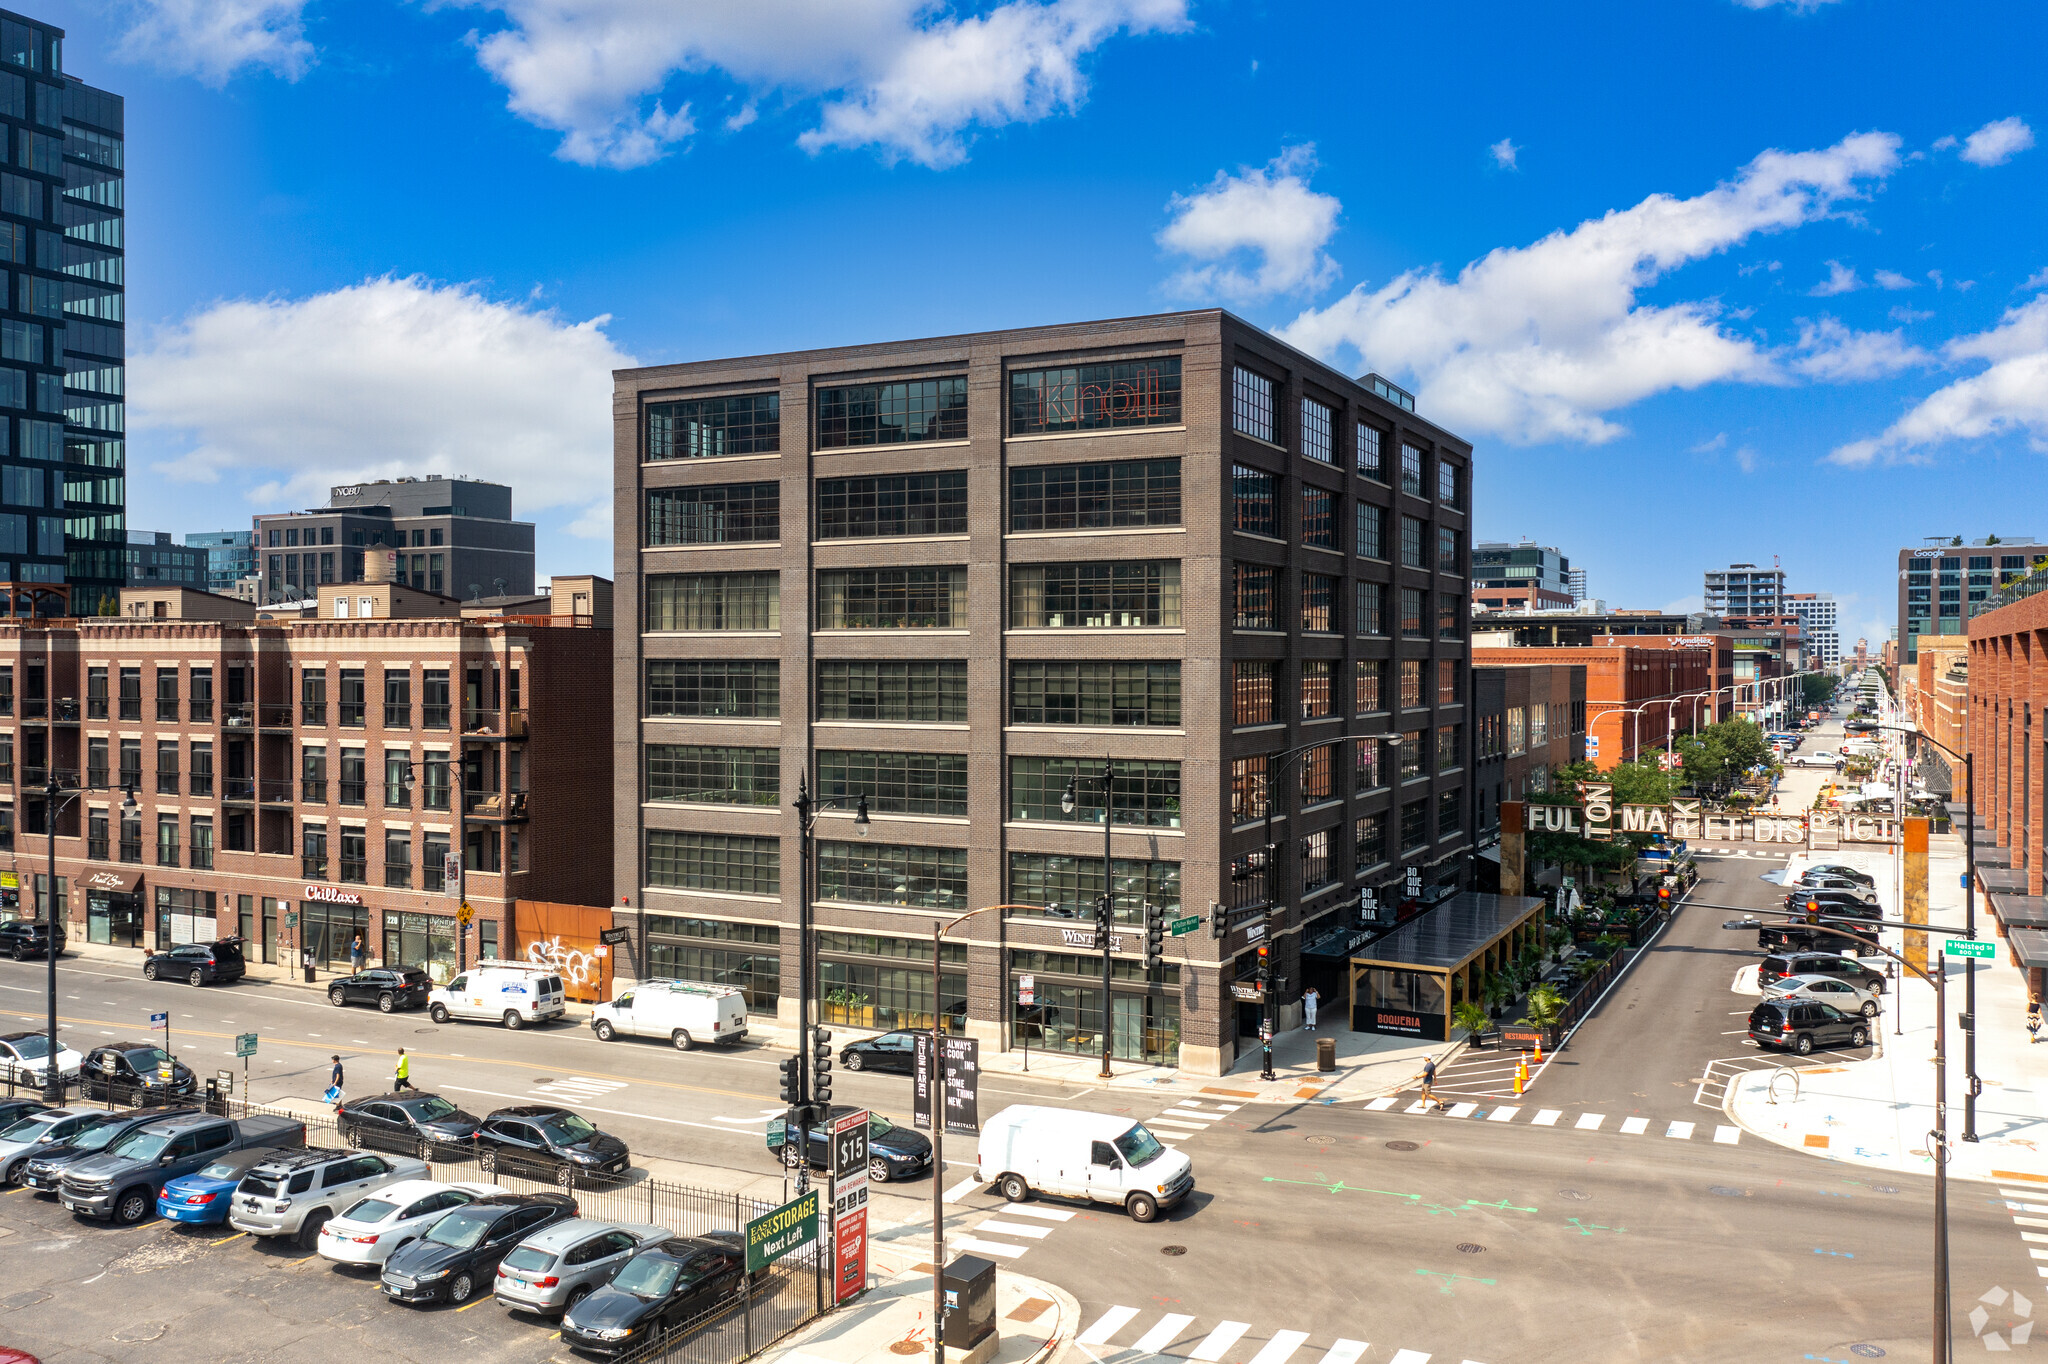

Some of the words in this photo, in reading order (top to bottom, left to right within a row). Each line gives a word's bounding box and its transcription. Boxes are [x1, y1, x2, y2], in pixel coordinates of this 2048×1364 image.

[1039, 369, 1158, 424] Knoll
[336, 486, 362, 496] NOBU
[1914, 550, 1945, 558] Google
[1407, 867, 1417, 876] BO
[89, 874, 109, 883] Nail
[107, 875, 124, 887] Spa
[1407, 877, 1422, 887] QUE
[305, 886, 359, 904] Chillaxx
[1362, 888, 1373, 898] BO
[1407, 887, 1420, 896] RIA
[1362, 899, 1378, 909] QUE
[1362, 909, 1376, 920] RIA
[387, 916, 398, 925] 220
[1062, 929, 1122, 946] WINTST
[1954, 942, 1984, 950] Halsted
[1378, 1013, 1420, 1027] BOQUERIA
[918, 1036, 926, 1066] FULTON
[947, 1040, 972, 1051] ALWAYS
[947, 1050, 964, 1060] COOK
[964, 1061, 974, 1071] ING
[947, 1068, 956, 1077] UP
[918, 1067, 926, 1098] MARKET
[947, 1078, 965, 1088] SOME
[956, 1088, 974, 1100] THING
[948, 1097, 962, 1107] NEW.
[837, 1118, 851, 1130] PUBLIC
[851, 1113, 866, 1125] PARKING
[948, 1120, 976, 1129] CARNIVALE
[841, 1136, 863, 1167] $15
[836, 1184, 846, 1195] EARN
[848, 1176, 867, 1189] REWARDS!
[773, 1197, 815, 1233] STORAGE
[751, 1218, 772, 1236] EAST
[839, 1215, 857, 1230] DOWNLOAD
[850, 1222, 861, 1233] TODAY!
[751, 1227, 772, 1245] BANK
[764, 1235, 785, 1257] Next
[787, 1226, 802, 1246] Left
